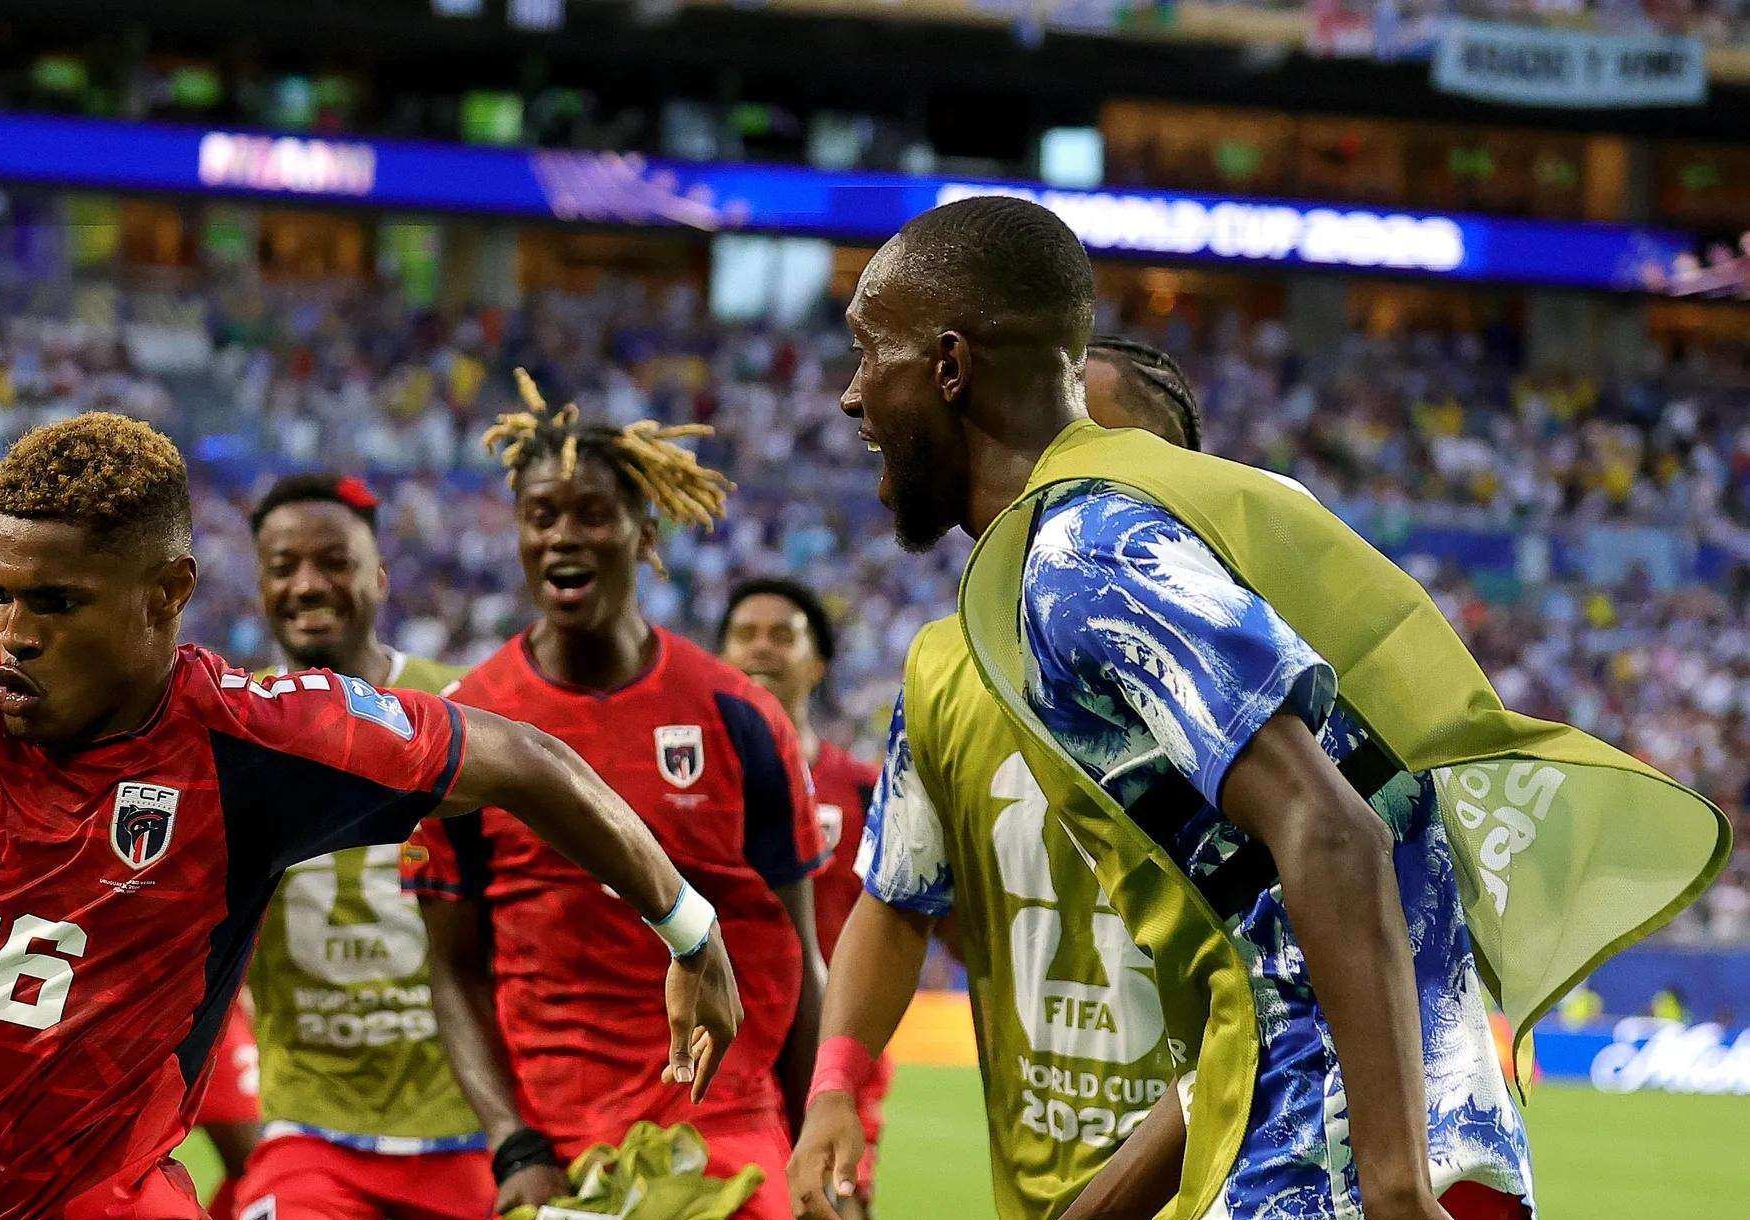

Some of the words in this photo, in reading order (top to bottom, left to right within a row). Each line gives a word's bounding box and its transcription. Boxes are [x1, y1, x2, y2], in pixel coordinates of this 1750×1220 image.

[122, 785, 175, 802] FCF
[1043, 995, 1119, 1034] FIFA
[1105, 1076, 1168, 1106] CUP
